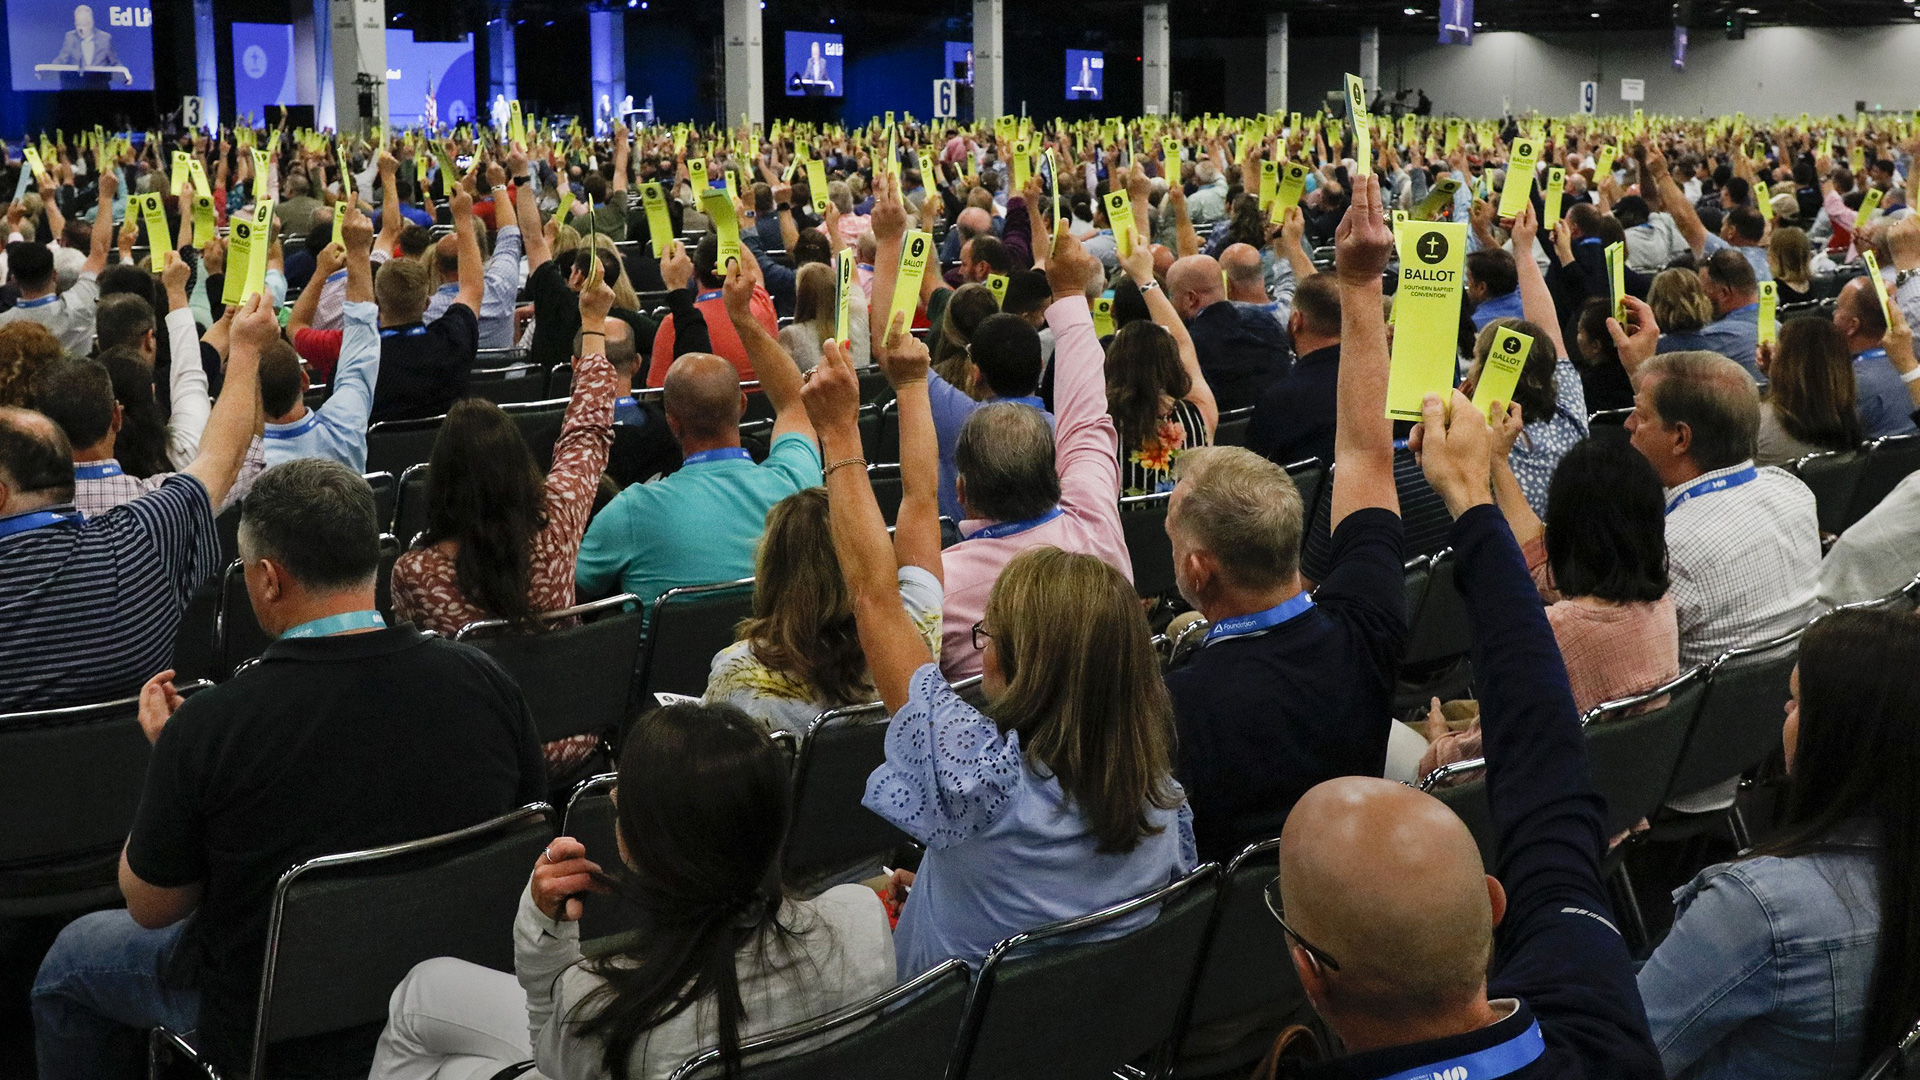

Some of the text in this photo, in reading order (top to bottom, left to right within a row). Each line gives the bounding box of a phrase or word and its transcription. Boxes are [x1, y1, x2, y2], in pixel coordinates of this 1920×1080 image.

[109, 6, 133, 26] Ed
[940, 81, 951, 115] 6
[1585, 83, 1593, 112] 9
[189, 98, 200, 126] 3
[1512, 157, 1534, 165] BALLOT
[231, 237, 251, 249] BALLO
[903, 258, 924, 268] BALLOT
[1404, 268, 1456, 282] BALLOT
[1403, 284, 1433, 292] SOUTHERN
[1410, 291, 1447, 299] CONVENTION
[1492, 352, 1521, 367] BALLOT
[1223, 620, 1257, 630] Foundation
